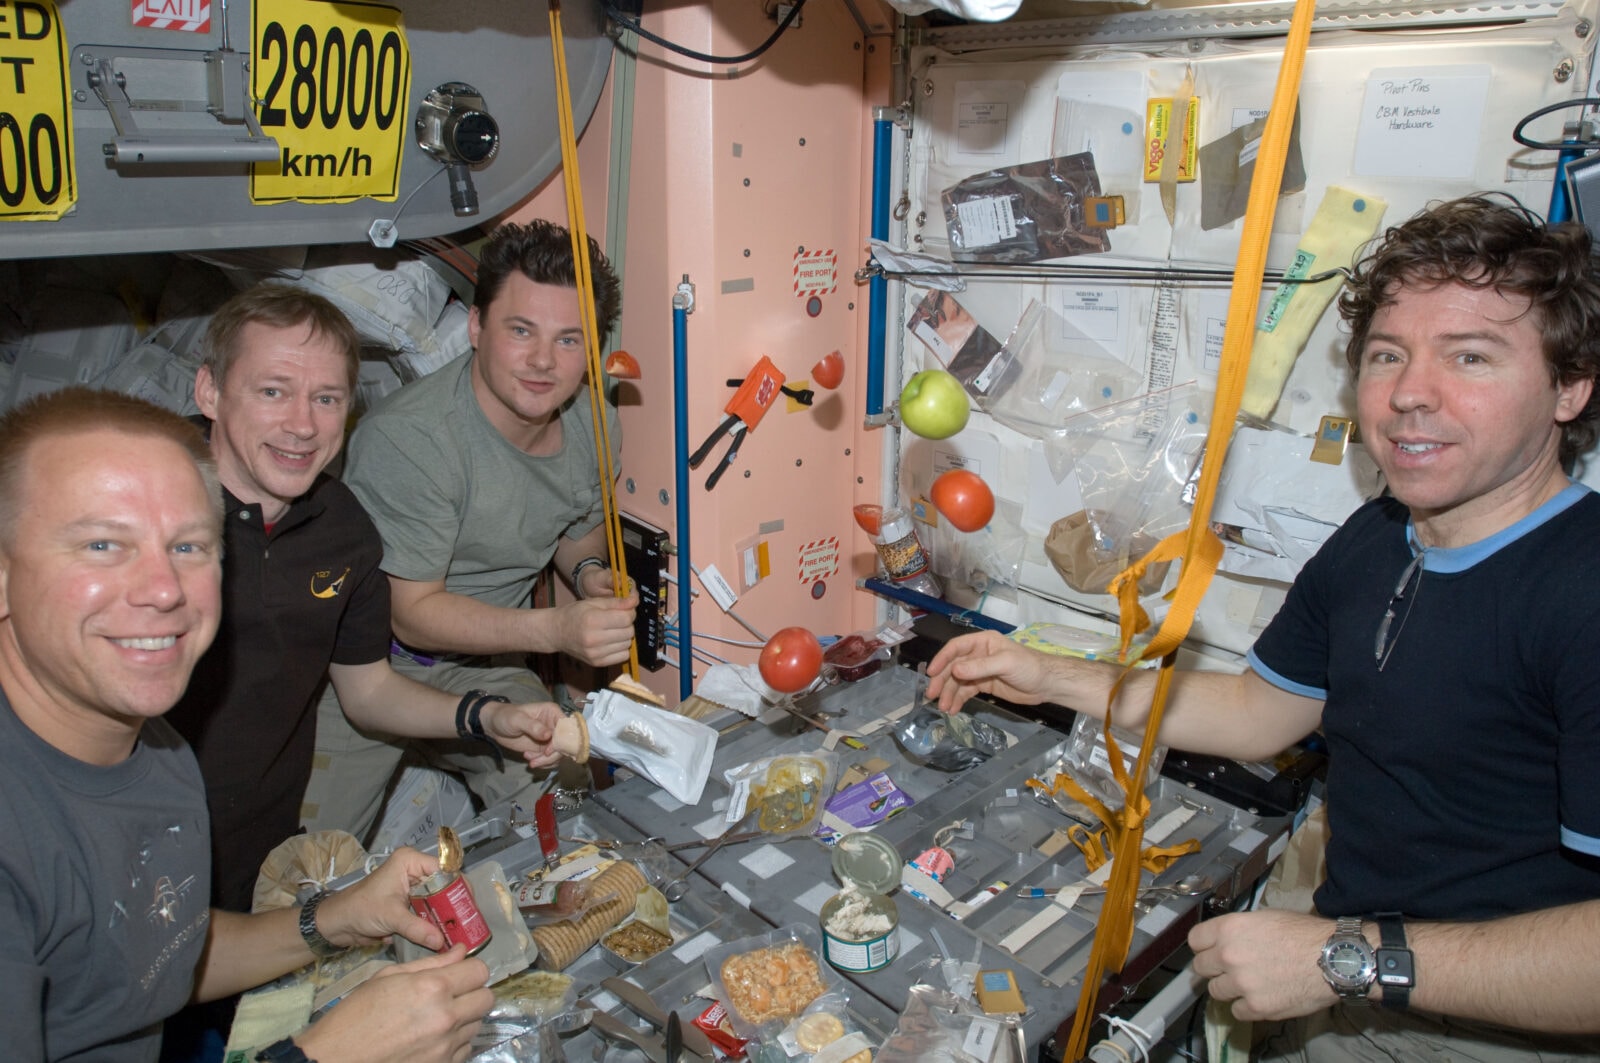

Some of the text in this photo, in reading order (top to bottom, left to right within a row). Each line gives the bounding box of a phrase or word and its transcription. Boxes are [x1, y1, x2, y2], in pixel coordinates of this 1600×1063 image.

[260, 21, 402, 131] 28000
[1380, 78, 1431, 95] Pivot Pins
[1388, 118, 1434, 131] Hardware
[282, 146, 372, 177] km/h
[800, 268, 832, 278] FIRE PORT
[804, 553, 834, 567] FIRE PORT
